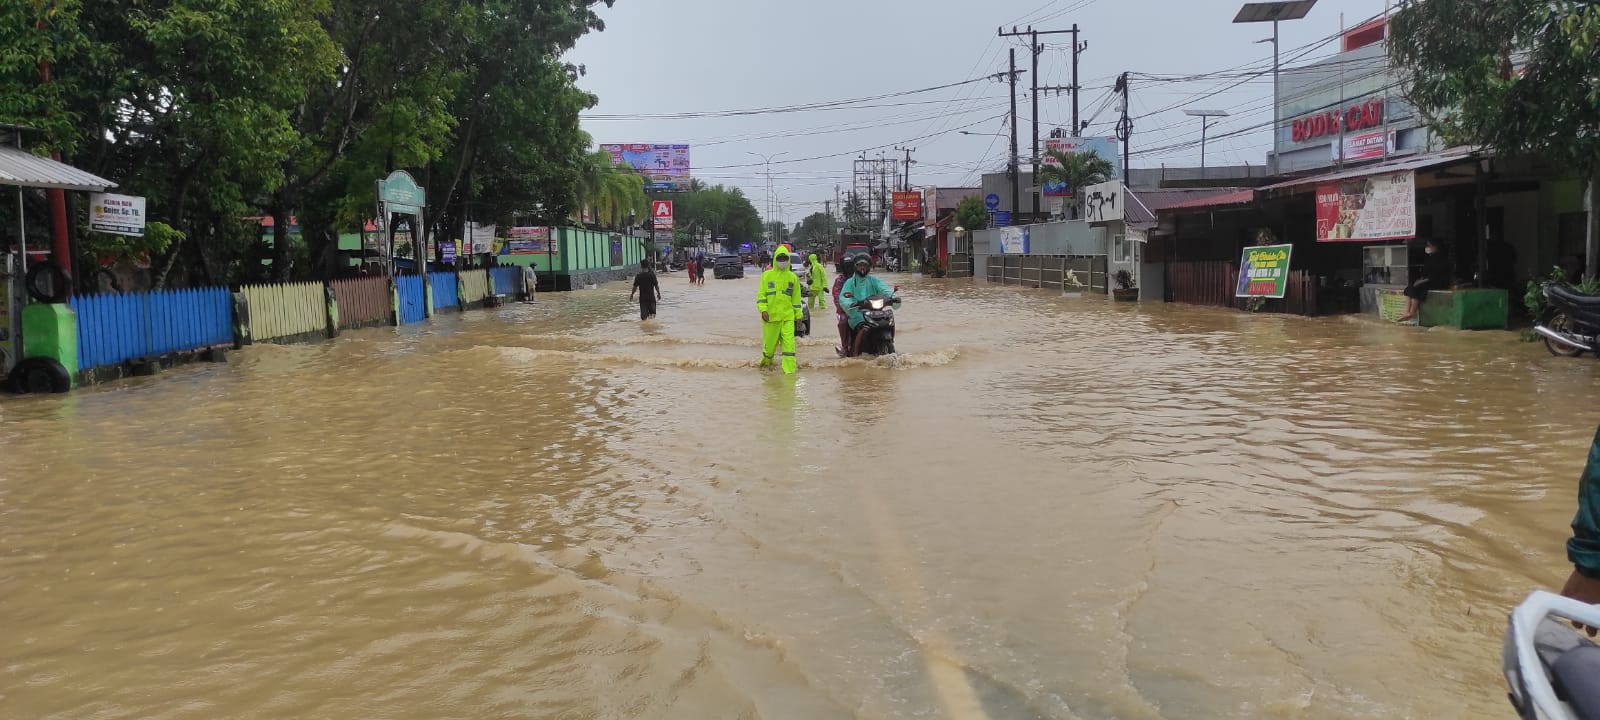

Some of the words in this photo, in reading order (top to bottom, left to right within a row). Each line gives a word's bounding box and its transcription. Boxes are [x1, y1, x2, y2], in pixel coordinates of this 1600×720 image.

[1347, 98, 1384, 131] CAT
[1366, 134, 1384, 146] DATAN
[656, 202, 670, 216] A
